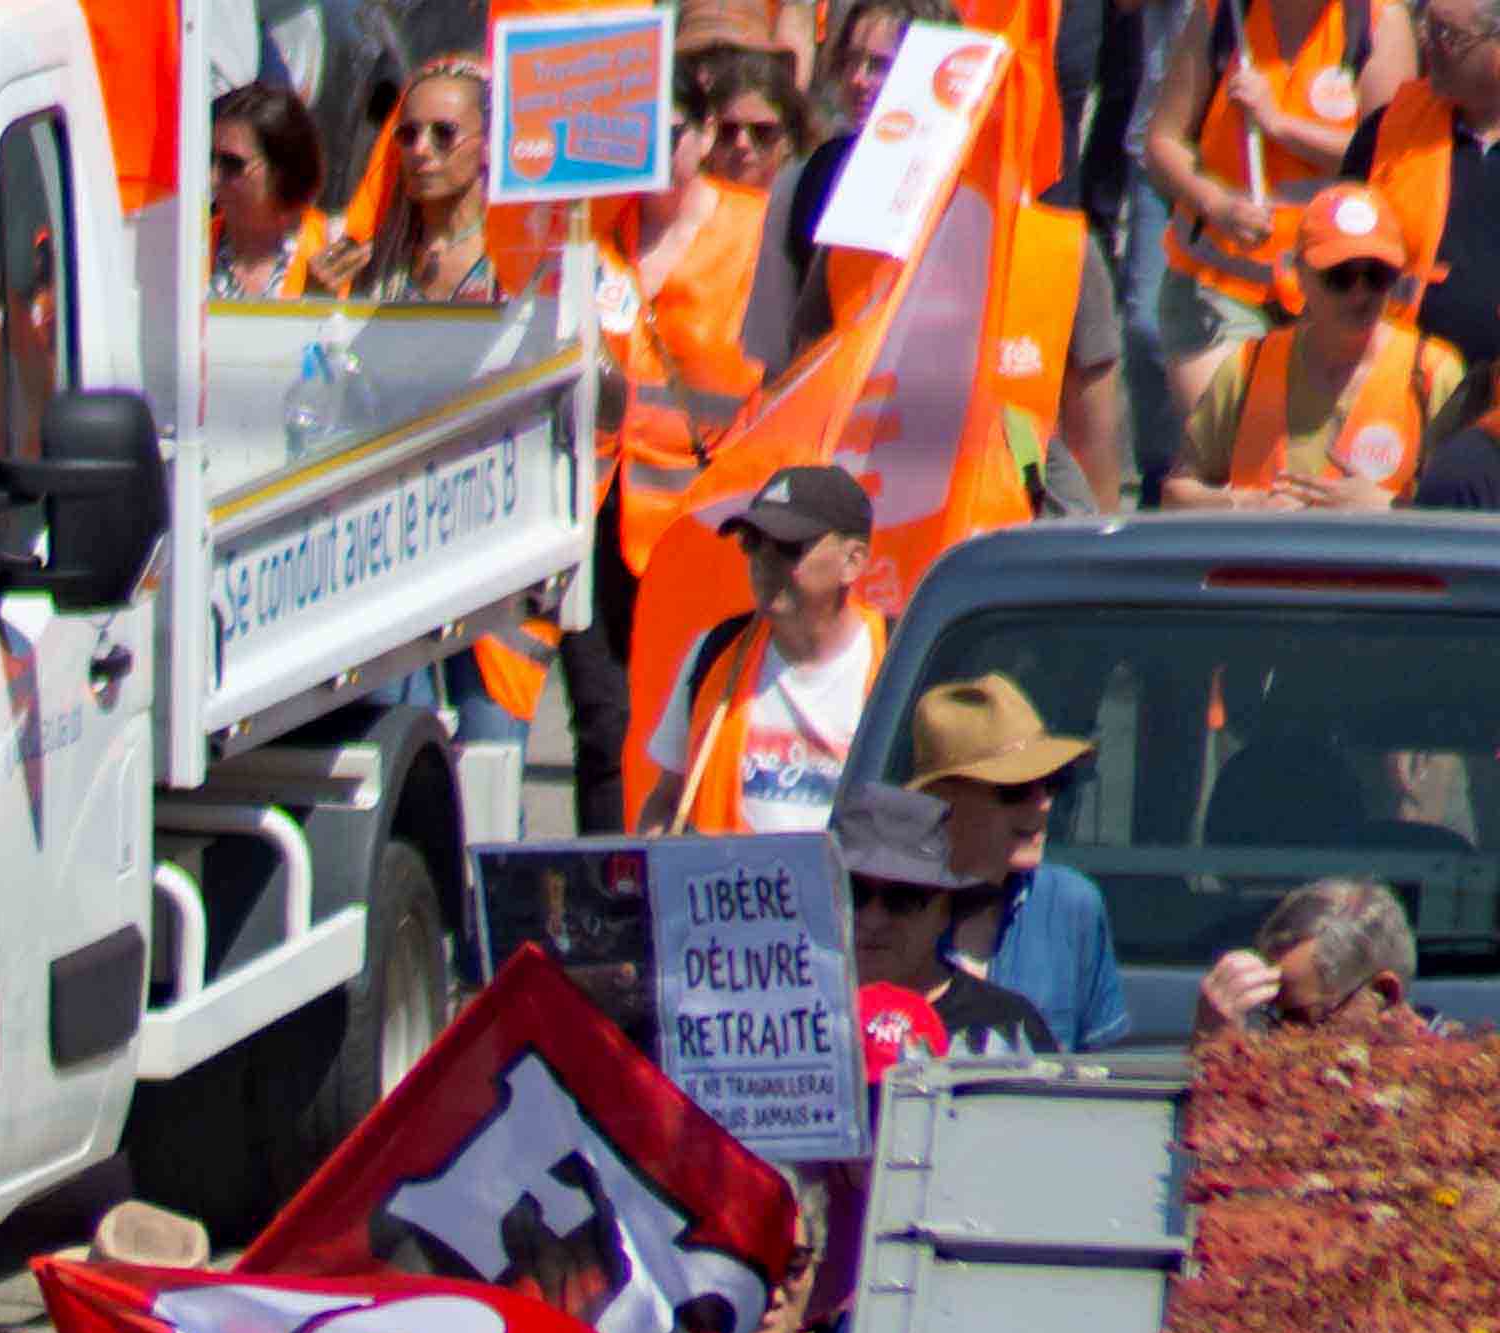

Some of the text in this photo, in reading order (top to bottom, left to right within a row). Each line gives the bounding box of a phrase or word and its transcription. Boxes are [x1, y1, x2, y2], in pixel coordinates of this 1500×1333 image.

[687, 866, 797, 927] LIBÉRÉ
[685, 932, 814, 993] DÉLIVRÉ
[676, 1000, 832, 1060] RETRAITÉ
